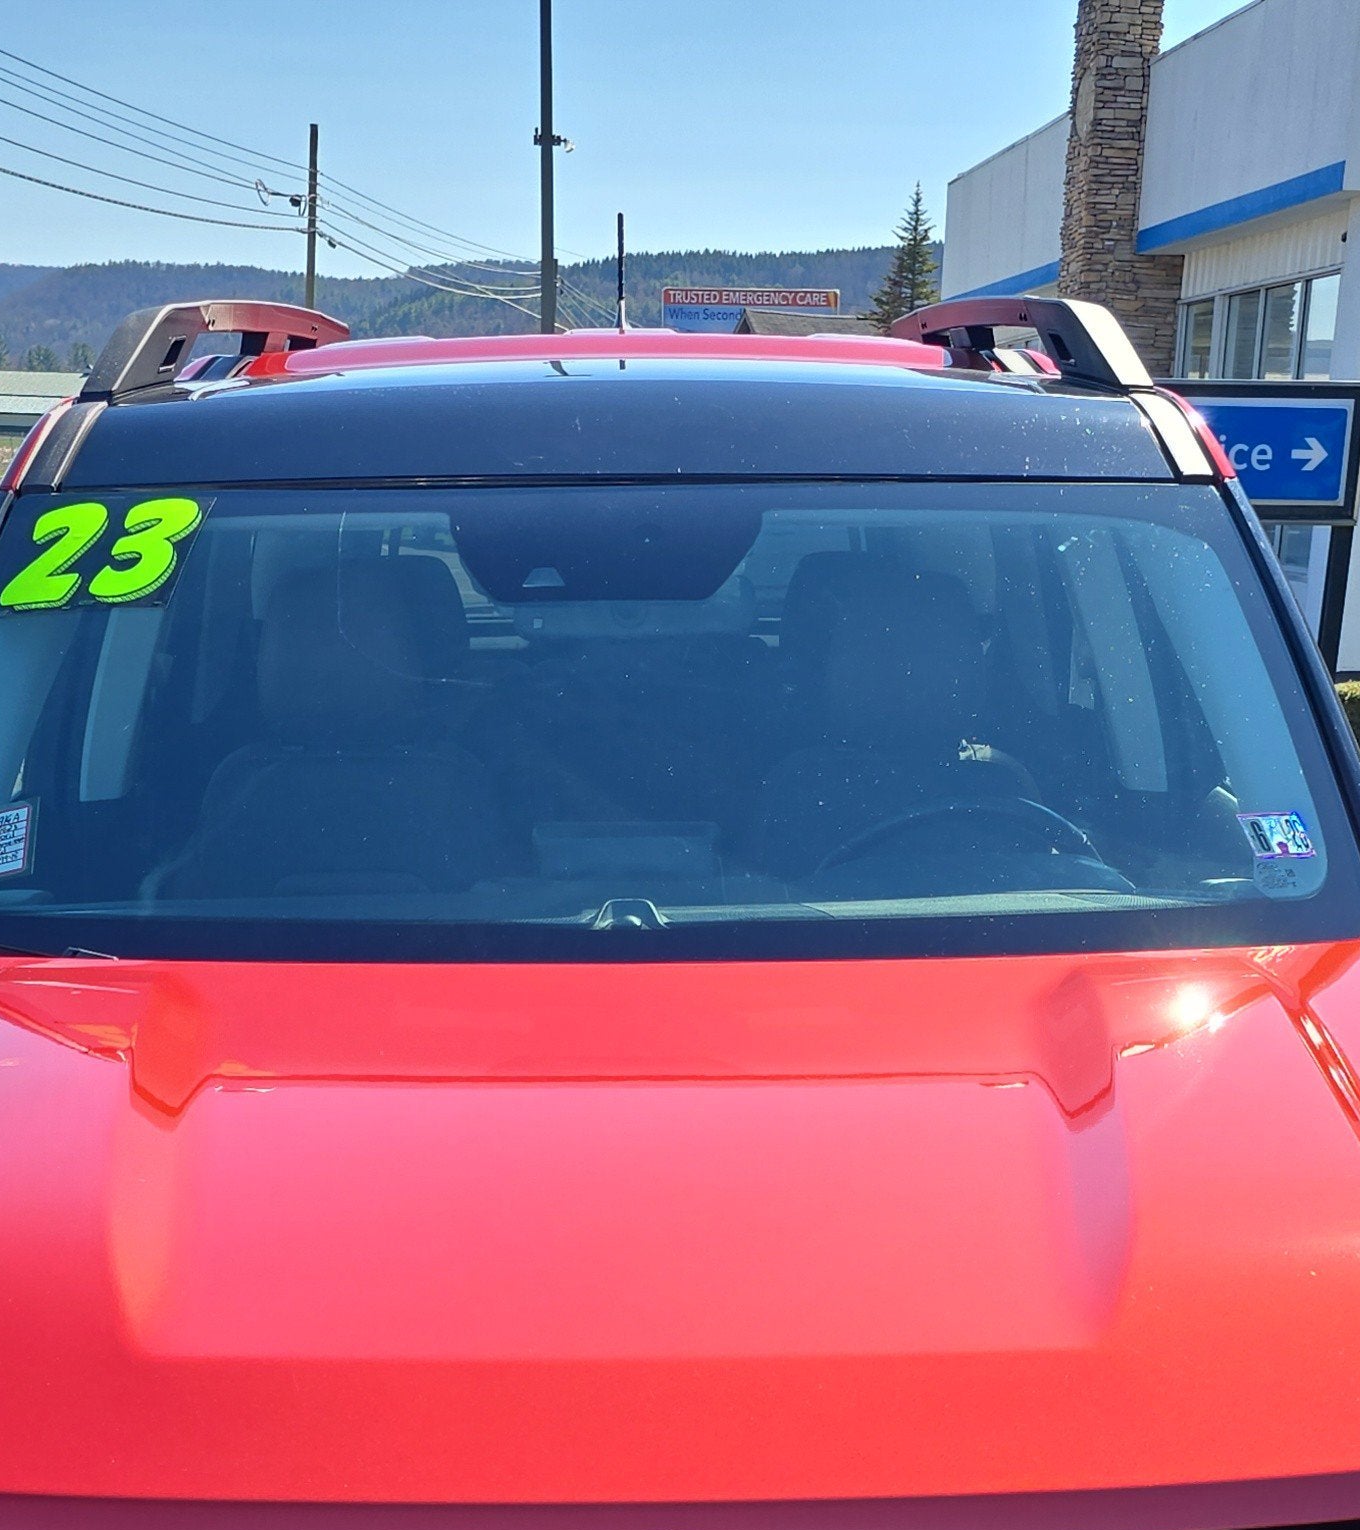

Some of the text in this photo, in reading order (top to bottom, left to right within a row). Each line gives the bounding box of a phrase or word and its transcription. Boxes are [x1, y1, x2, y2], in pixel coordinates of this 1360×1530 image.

[668, 290, 828, 306] TRUSTED EMERGENCY CARE
[668, 307, 700, 321] When
[0, 498, 202, 612] 23
